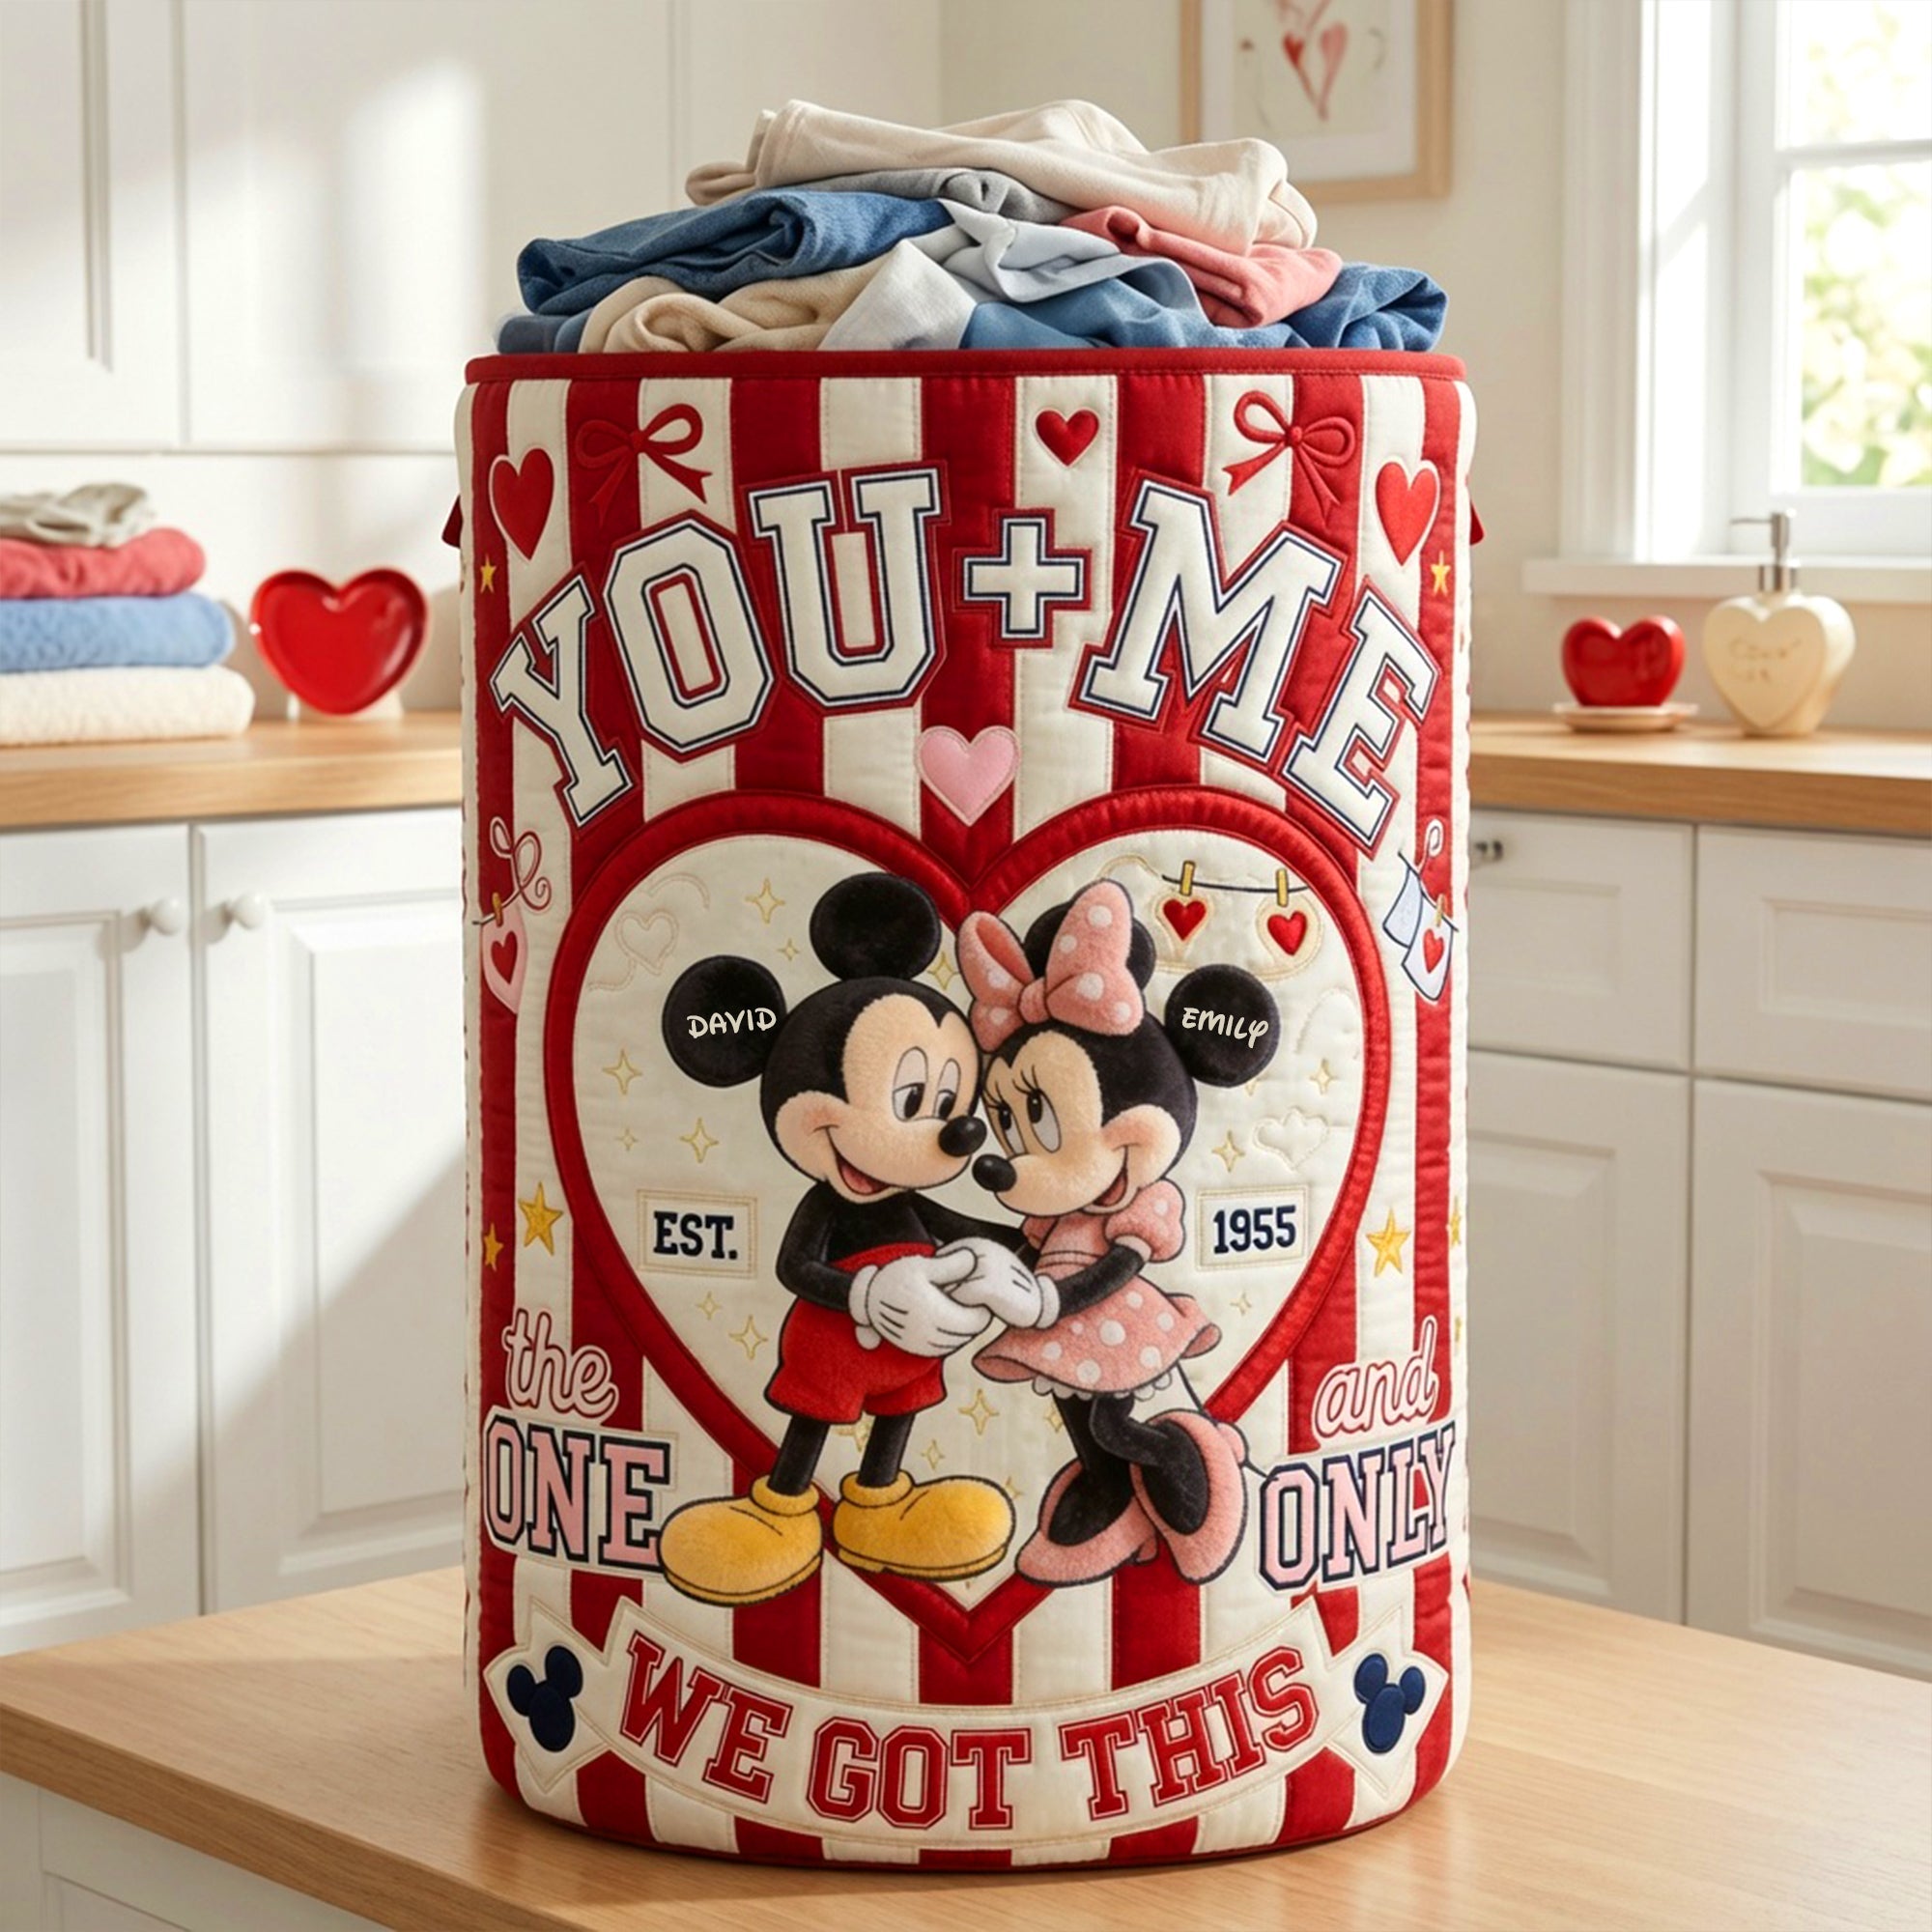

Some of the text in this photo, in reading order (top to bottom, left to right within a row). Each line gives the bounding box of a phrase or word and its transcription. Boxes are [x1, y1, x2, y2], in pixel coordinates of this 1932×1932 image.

[687, 1008, 777, 1038] DAVID
[1181, 1008, 1270, 1049] EMILY
[653, 1210, 738, 1260] EST.
[1213, 1205, 1296, 1254] 1955
[502, 1308, 617, 1419] the
[1315, 1319, 1436, 1438] and
[486, 1414, 670, 1573] ONE
[1260, 1420, 1456, 1591] ONLY
[620, 1630, 1320, 1831] WE GOT THIS
